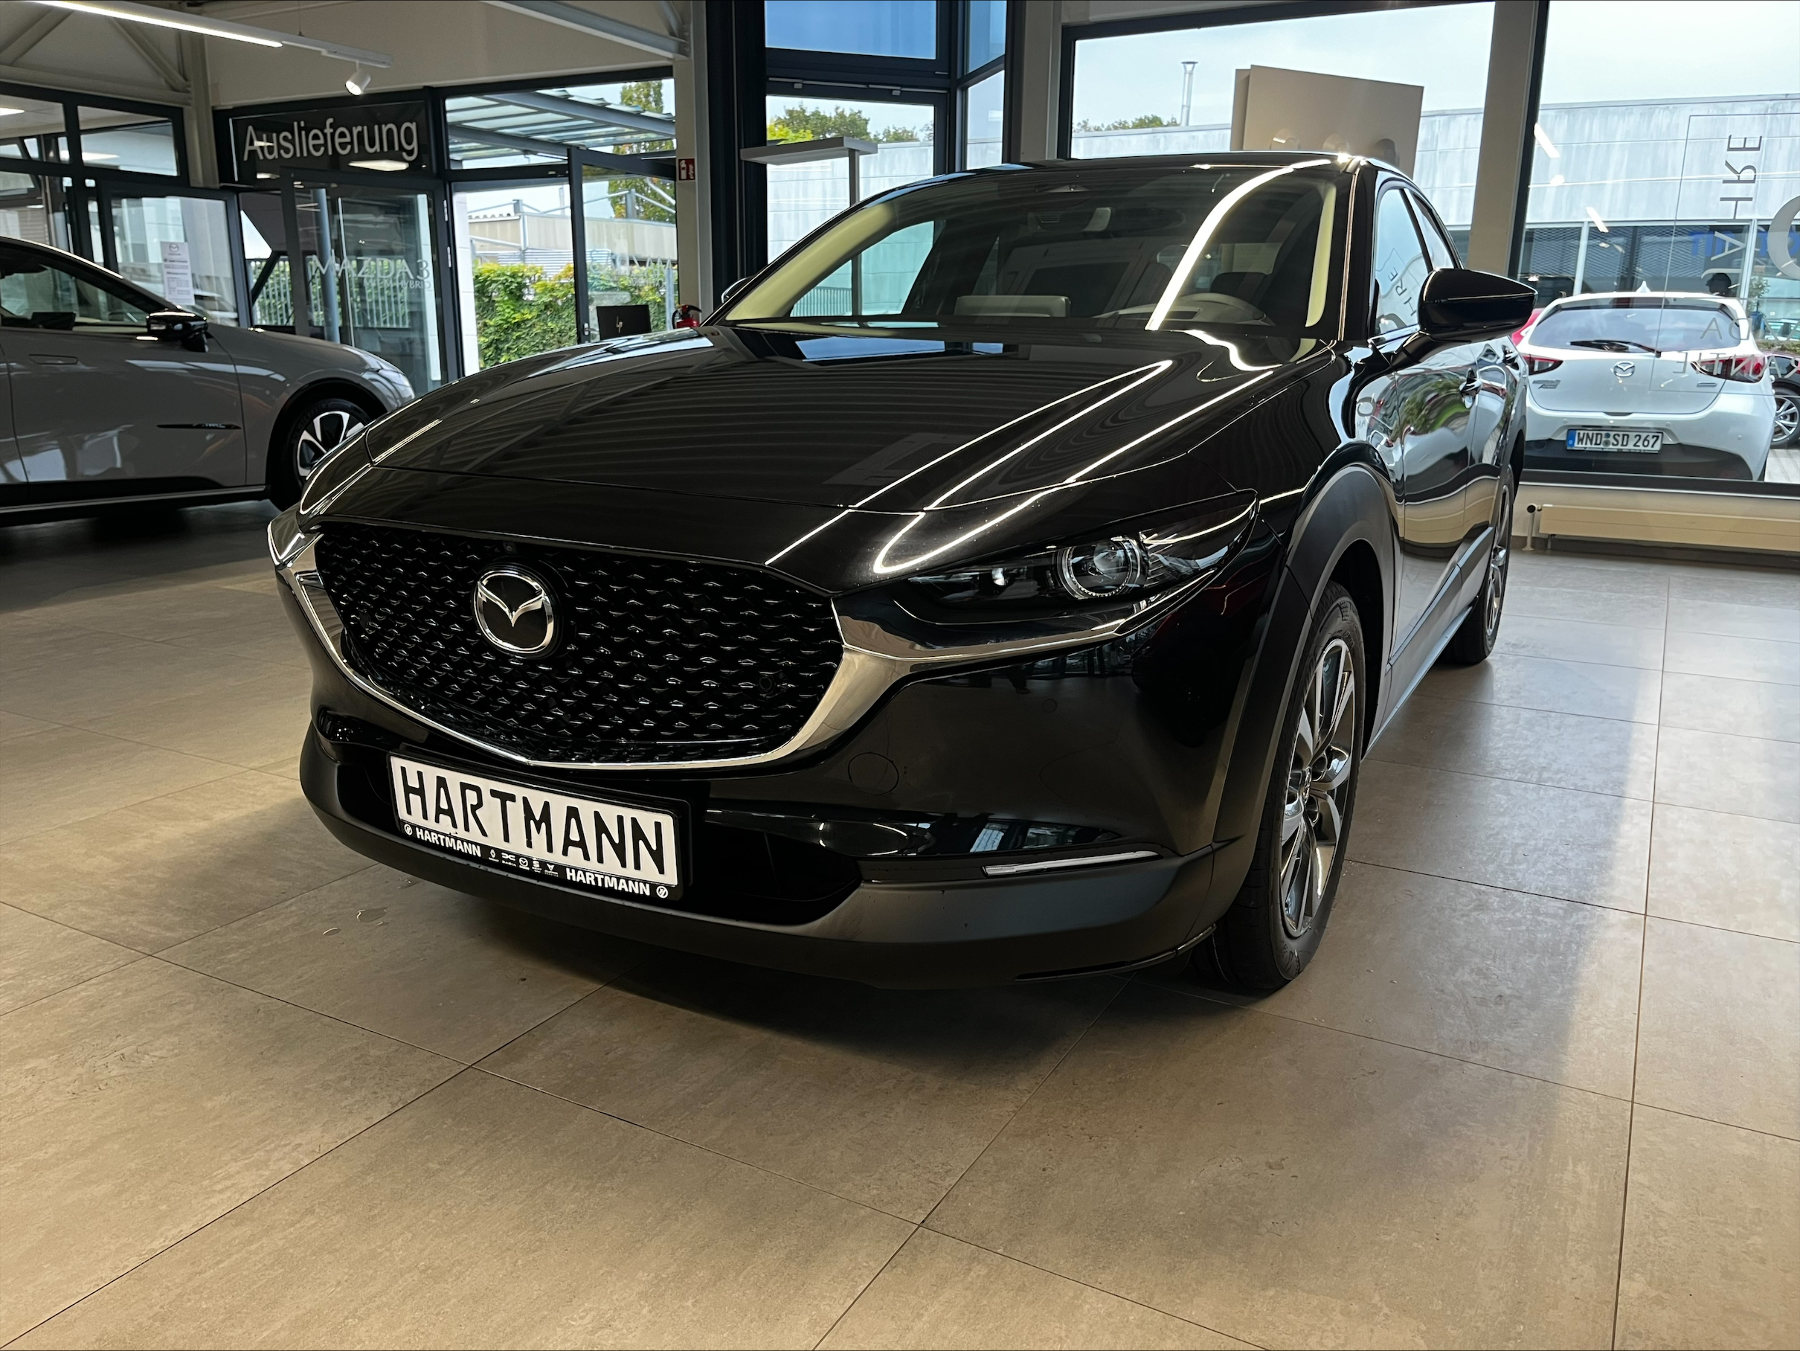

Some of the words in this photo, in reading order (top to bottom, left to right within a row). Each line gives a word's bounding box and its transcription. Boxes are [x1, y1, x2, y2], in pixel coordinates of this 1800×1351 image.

[243, 117, 419, 162] Auslieferung
[1576, 432, 1603, 447] WND
[1612, 433, 1630, 448] SD
[1633, 434, 1660, 449] 267
[400, 765, 665, 875] HARTMANN
[416, 827, 481, 857] HARTMANN
[566, 867, 650, 896] HARTMANN
